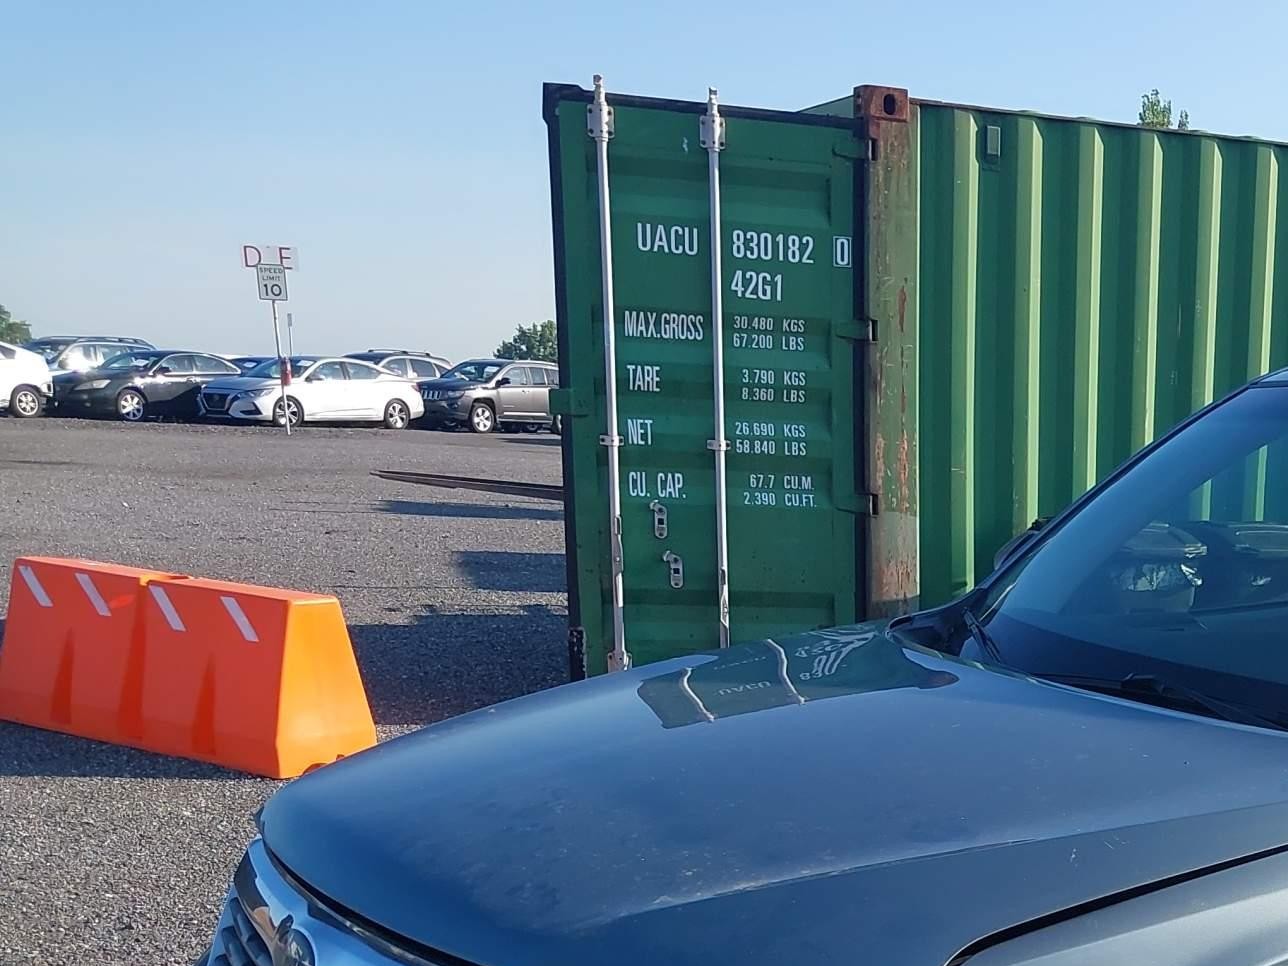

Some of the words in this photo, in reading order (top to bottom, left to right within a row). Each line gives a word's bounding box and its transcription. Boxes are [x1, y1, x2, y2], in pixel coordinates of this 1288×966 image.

[637, 222, 698, 256] UACU
[732, 230, 814, 264] 830182
[835, 238, 849, 265] 0
[243, 245, 261, 267] D
[263, 283, 282, 297] 10
[731, 270, 783, 301] 42G1
[624, 310, 704, 341] MAX.GROSS
[733, 316, 774, 331] 30.480
[782, 319, 806, 333] KGS
[733, 335, 773, 350] 67.200
[782, 336, 805, 351] LBS
[627, 364, 661, 393] TARE
[742, 369, 774, 385] 3.790
[783, 371, 806, 386] KGS
[742, 387, 774, 402] 8.360
[783, 389, 805, 403] LBS
[627, 419, 653, 445] NET
[735, 422, 775, 437] 26.690
[783, 423, 806, 438] KGS
[735, 440, 776, 455] 58.840
[784, 442, 806, 457] LBS
[628, 471, 650, 497] CU.
[657, 473, 686, 499] CAP.
[750, 474, 774, 489] 67.7
[783, 476, 814, 491] CU.M.
[744, 492, 776, 506] 2.390
[784, 494, 817, 508] CU.FT.
